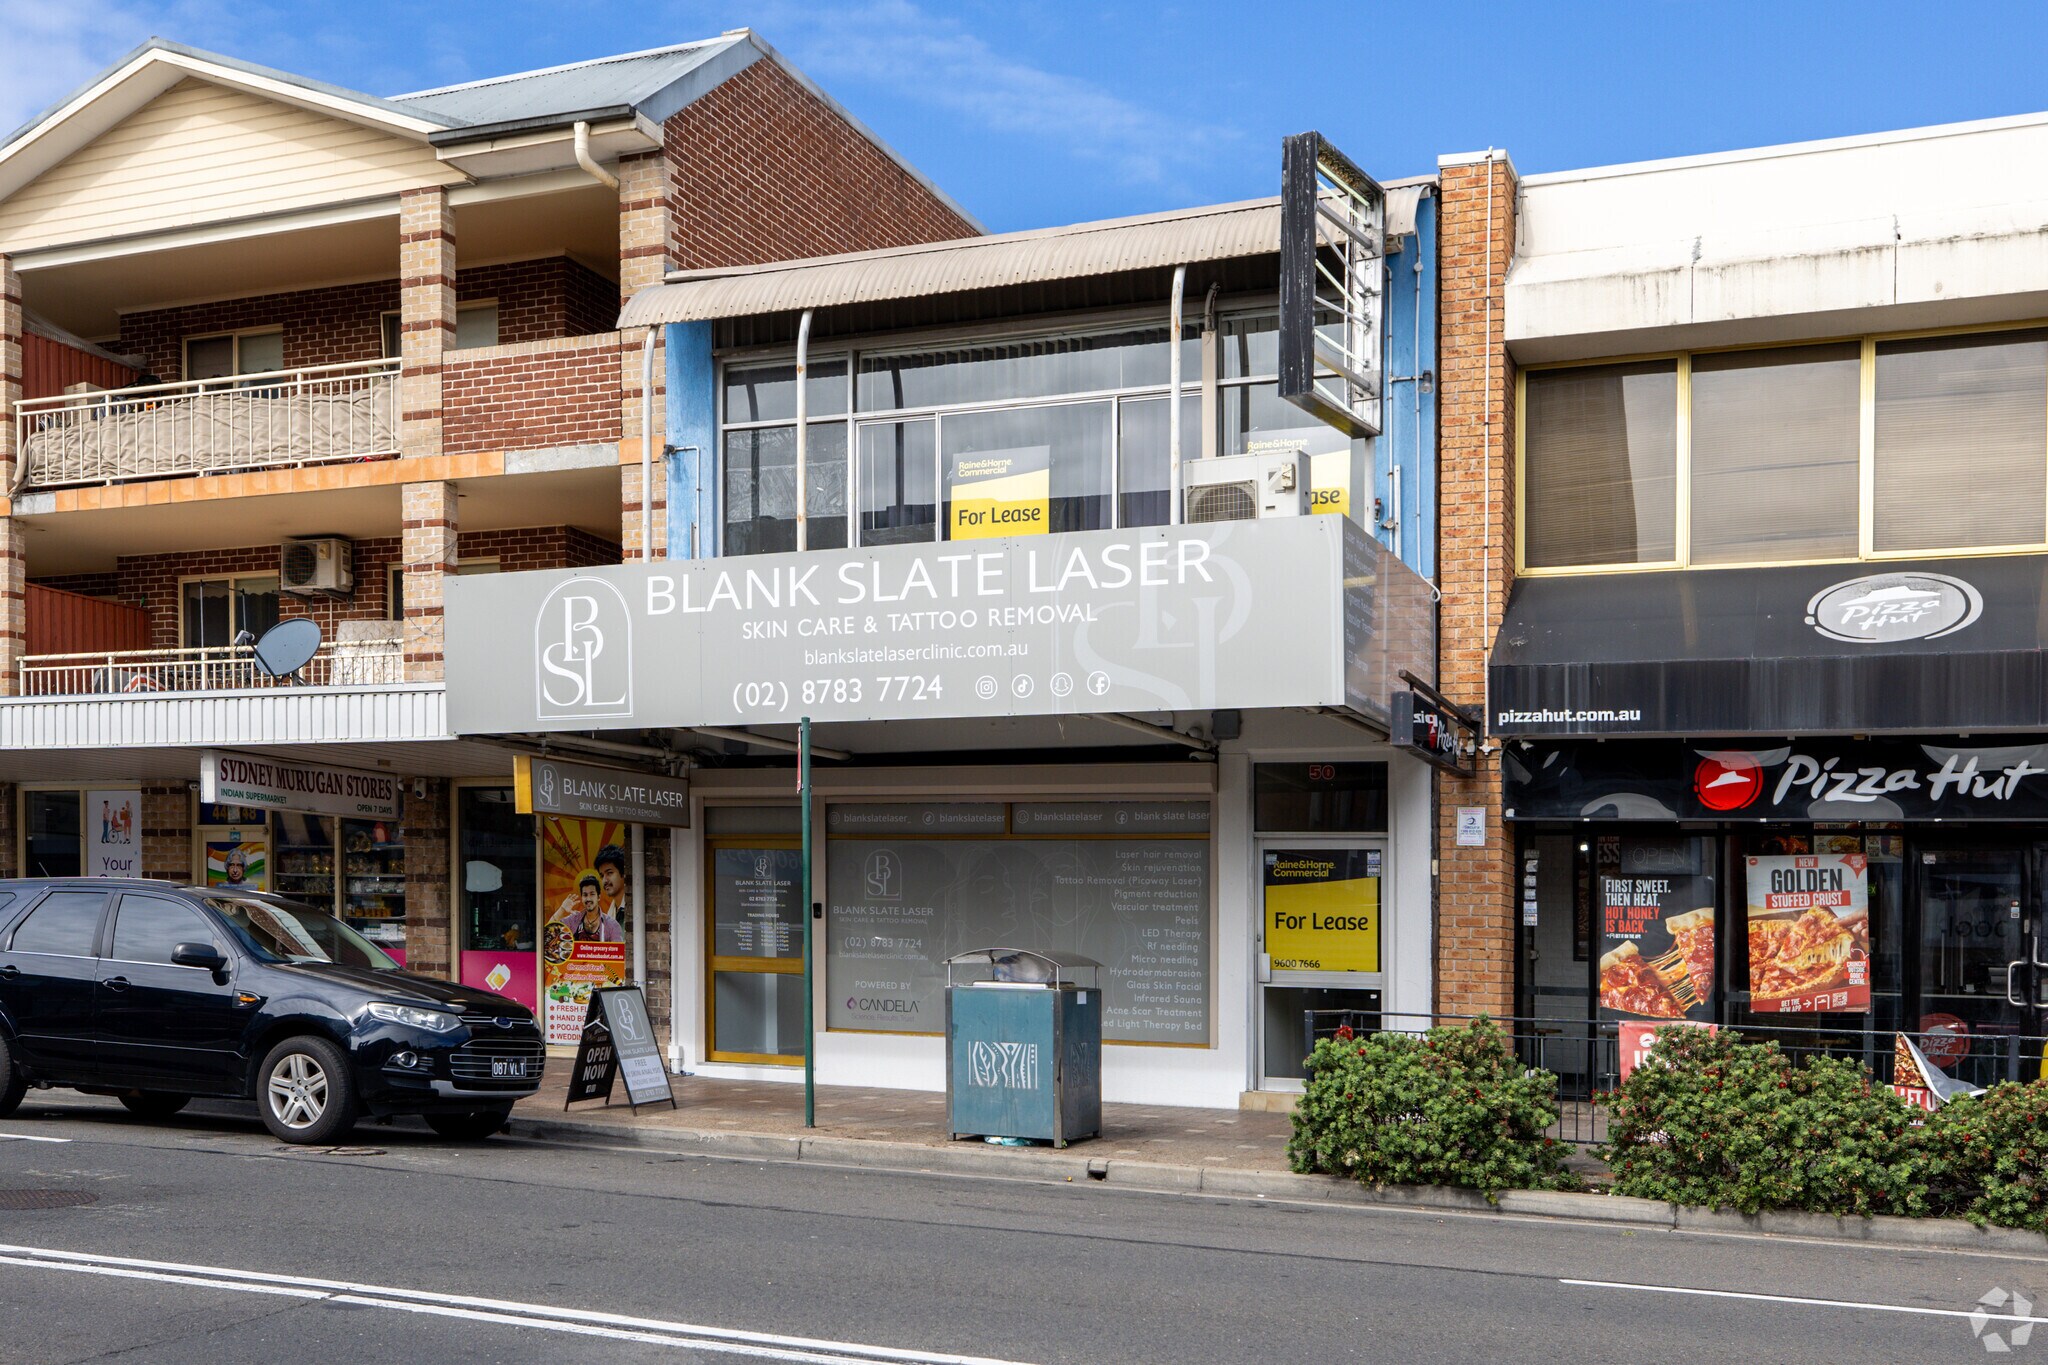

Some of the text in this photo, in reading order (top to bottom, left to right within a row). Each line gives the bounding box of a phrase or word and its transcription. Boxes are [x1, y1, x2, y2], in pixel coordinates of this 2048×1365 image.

[958, 465, 1008, 478] Commercial
[1311, 488, 1341, 505] ase
[958, 507, 1041, 526] For Lease
[646, 539, 1214, 616] BLANK SLATE LASER
[1840, 597, 1941, 625] Pizza
[742, 603, 1098, 641] SKIN CARE & TATTOO REMOVAL
[1859, 609, 1929, 631] Hut
[804, 641, 1029, 666] blankslatelaserclinic.com.au
[733, 675, 944, 714] (02) 8783 7724
[1498, 707, 1641, 726] pizzahut.com.au
[220, 757, 393, 801] SYDNEY MURUGAN STORES
[1309, 764, 1336, 781] 50
[1773, 754, 2047, 806] Pizza Hut
[220, 788, 287, 804] INDIAN SUPERMARKET
[563, 778, 683, 808] BLANK SLATE LASER
[356, 803, 393, 815] OPEN 7 DAYS
[579, 802, 592, 811] SKIN
[593, 803, 608, 813] CARE
[615, 806, 637, 816] TATTOO
[637, 808, 662, 819] REMOVAL
[1134, 810, 1210, 821] blank slate laser
[939, 812, 1006, 823] blankslatelaser
[1034, 811, 1103, 822] blankslatelaser
[1115, 850, 1202, 859] Laser hair removal
[1632, 847, 1686, 865] OPEN
[102, 856, 133, 871] Your
[1121, 863, 1202, 873] Skin rejuvenation
[1798, 858, 1814, 867] NEW
[1273, 868, 1329, 877] Commercial
[1055, 875, 1202, 887] Tattoo Removal (Picoway Laser)
[1605, 879, 1671, 893] FIRST SWEET.
[1771, 868, 1843, 894] GOLDEN
[1114, 889, 1198, 900] Pigment reduction
[1605, 893, 1661, 907] THEN HEAT.
[1771, 892, 1843, 908] STUFFED CRUST
[833, 905, 934, 917] BLANK SLATE LASER
[1111, 902, 1199, 912] Vascular treatment
[1605, 906, 1660, 920] HOT HONEY
[1175, 916, 1200, 925] Peels
[1275, 912, 1369, 931] For Lease
[1605, 920, 1648, 933] IS BACK.
[1142, 928, 1202, 939] LED Therapy
[593, 945, 608, 953] grocery
[844, 936, 922, 949] (02) 8783 7724
[1147, 942, 1199, 953] Rf needling
[839, 951, 929, 961] blankslatelaserclinic.com.au
[1131, 955, 1199, 966] Micro needling
[1274, 959, 1321, 968] 9600 7666
[1110, 967, 1202, 978] Hydrodermabrasion
[855, 980, 911, 990] POWERED BY
[1126, 981, 1202, 991] Glass Skin Facial
[1134, 994, 1202, 1004] Infrared Sauna
[1106, 1006, 1202, 1017] Acne Scar Treatment
[556, 1023, 580, 1031] POOJA
[1101, 1019, 1202, 1031] ed Light Therapy Bed
[1920, 1036, 1957, 1049] Pizza
[587, 1046, 612, 1064] OPEN
[493, 1062, 508, 1075] 087
[634, 1058, 647, 1067] FREE
[582, 1063, 608, 1082] NOW
